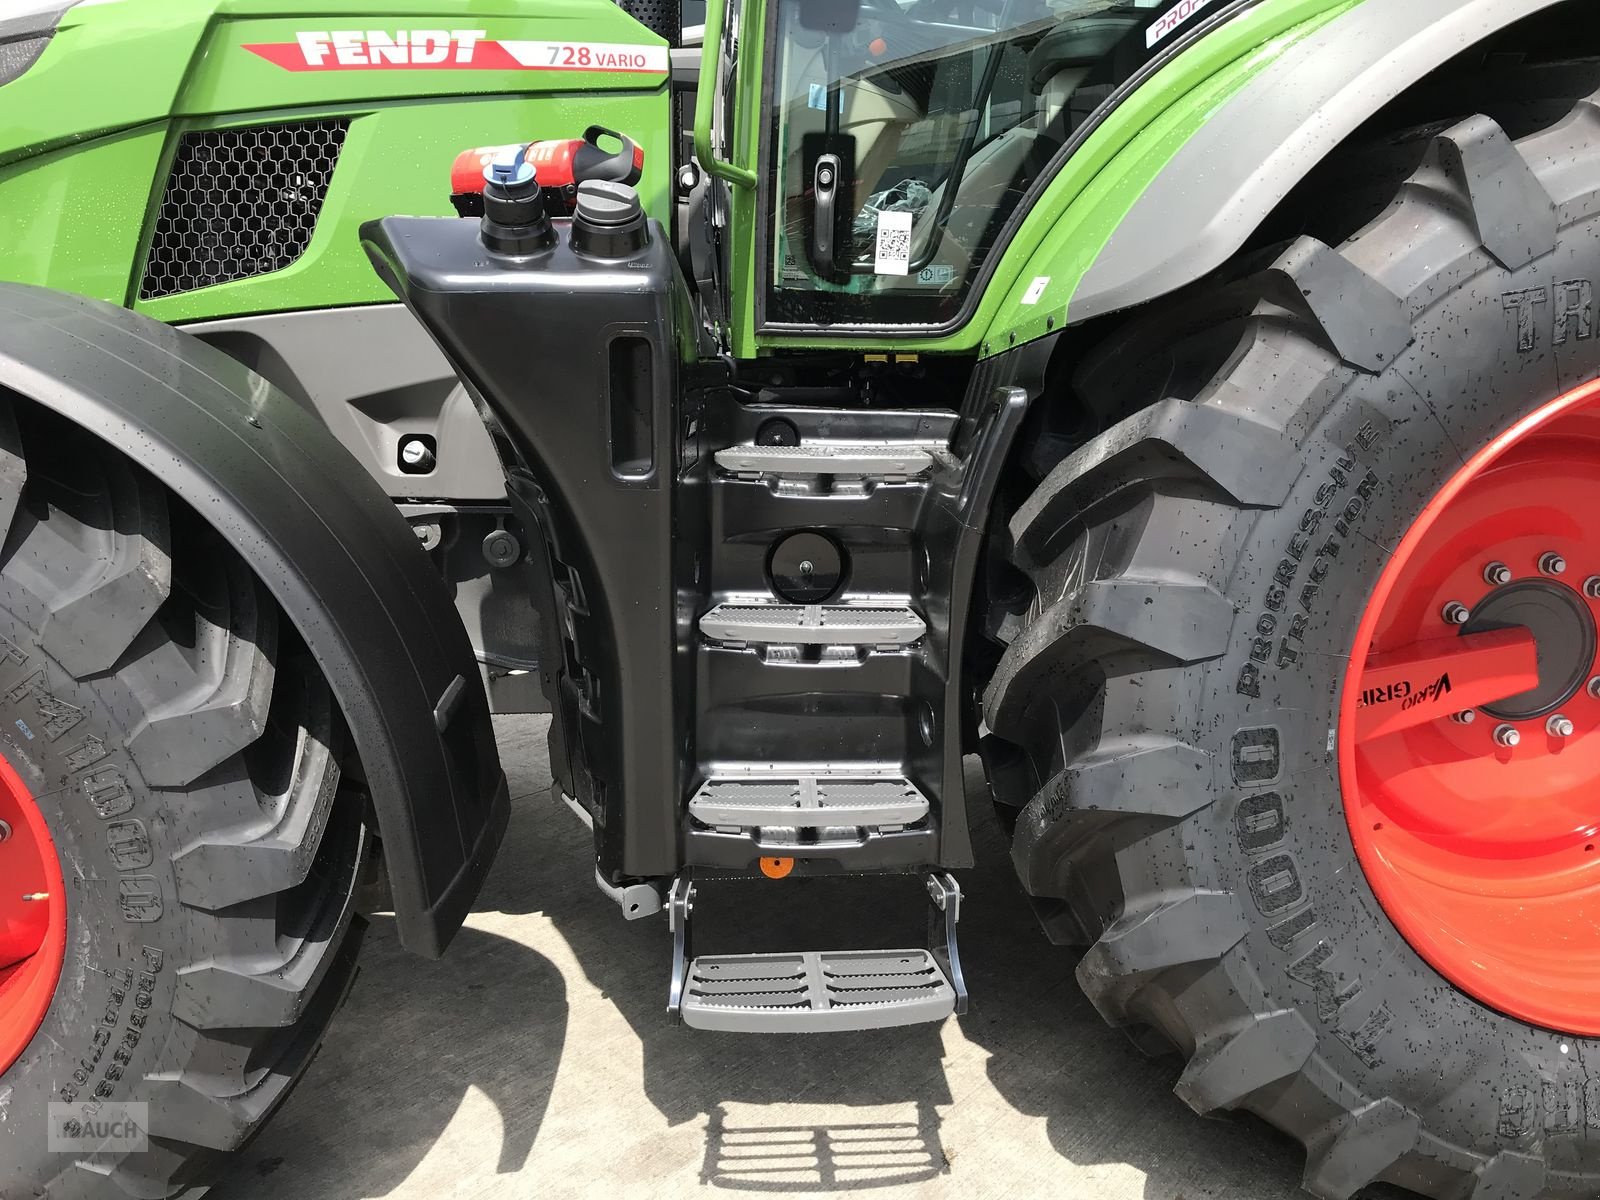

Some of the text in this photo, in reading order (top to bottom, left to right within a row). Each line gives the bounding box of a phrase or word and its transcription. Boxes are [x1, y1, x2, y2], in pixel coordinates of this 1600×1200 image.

[295, 29, 647, 68] FENDT 728 VARIO
[1500, 277, 1600, 354] TR
[1236, 419, 1381, 699] PROGRESSIVE
[1275, 468, 1380, 670] TRACTION
